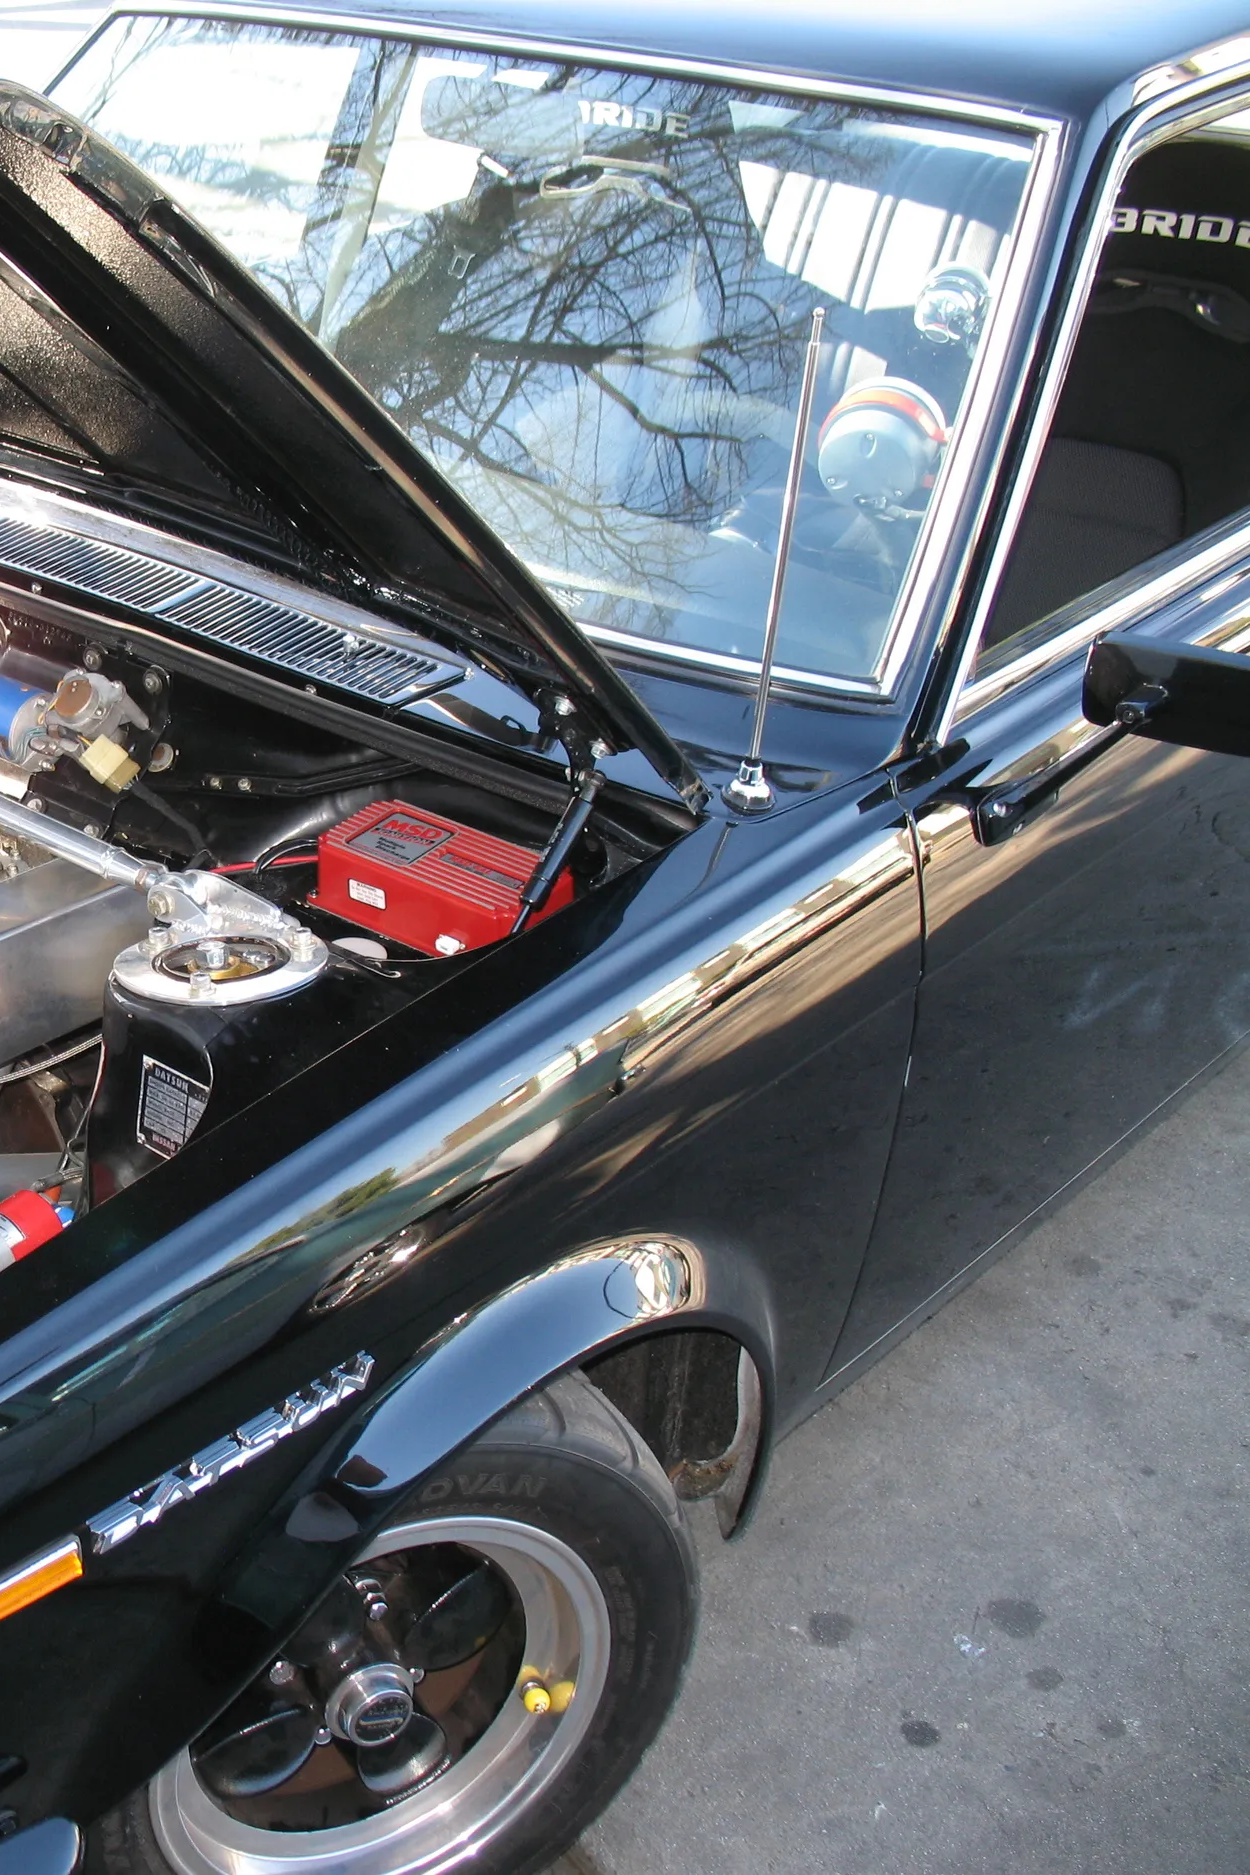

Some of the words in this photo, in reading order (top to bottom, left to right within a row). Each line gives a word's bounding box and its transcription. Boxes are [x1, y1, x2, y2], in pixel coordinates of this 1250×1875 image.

[381, 819, 444, 840] MSD
[154, 1067, 190, 1093] DATSUN
[86, 1350, 375, 1554] DATSUN
[418, 1472, 548, 1502] DVAN
